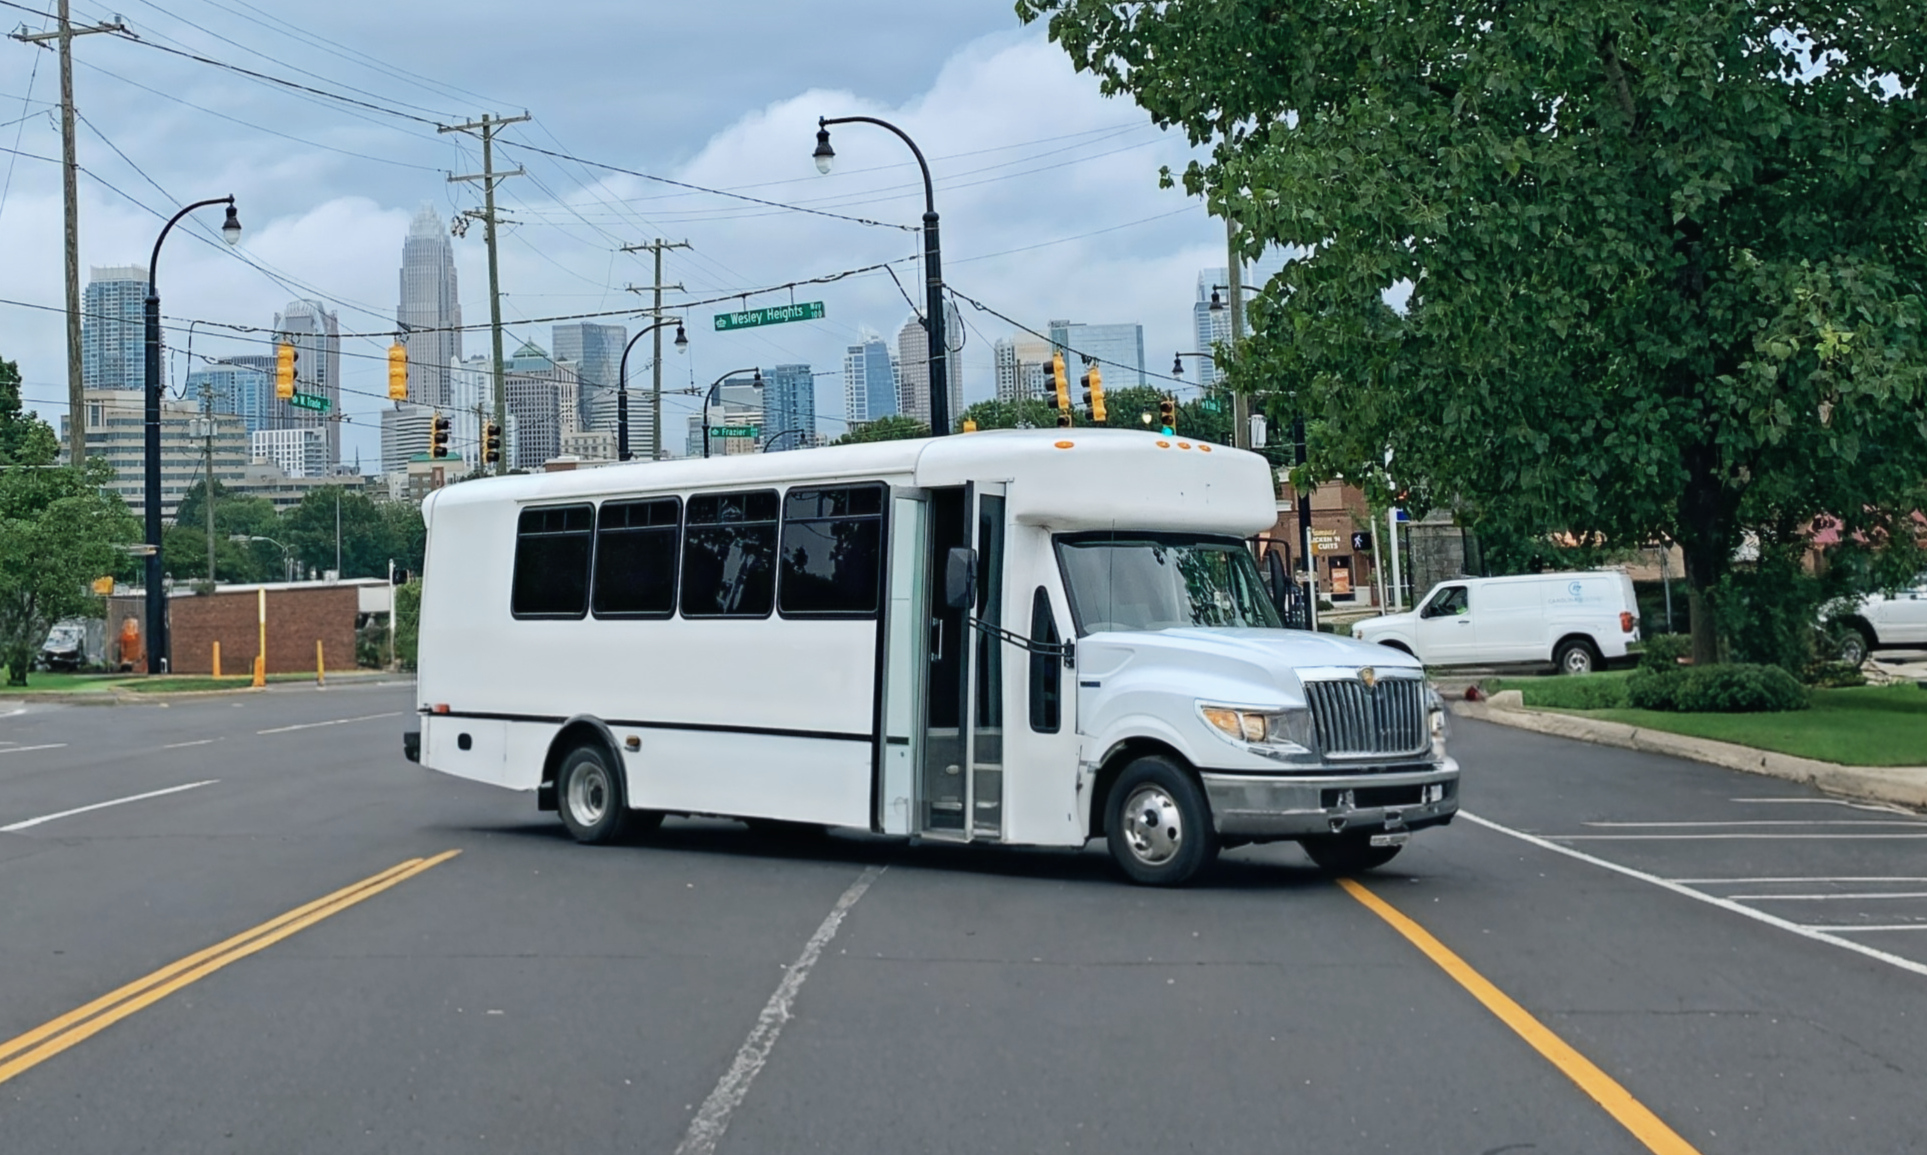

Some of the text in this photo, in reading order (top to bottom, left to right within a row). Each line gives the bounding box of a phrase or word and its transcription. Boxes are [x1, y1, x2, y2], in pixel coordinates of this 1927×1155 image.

[730, 302, 821, 325] Wesley Heights Way
[307, 396, 321, 409] Trade
[721, 427, 746, 436] Frazier
[1318, 542, 1339, 550] CUITS
